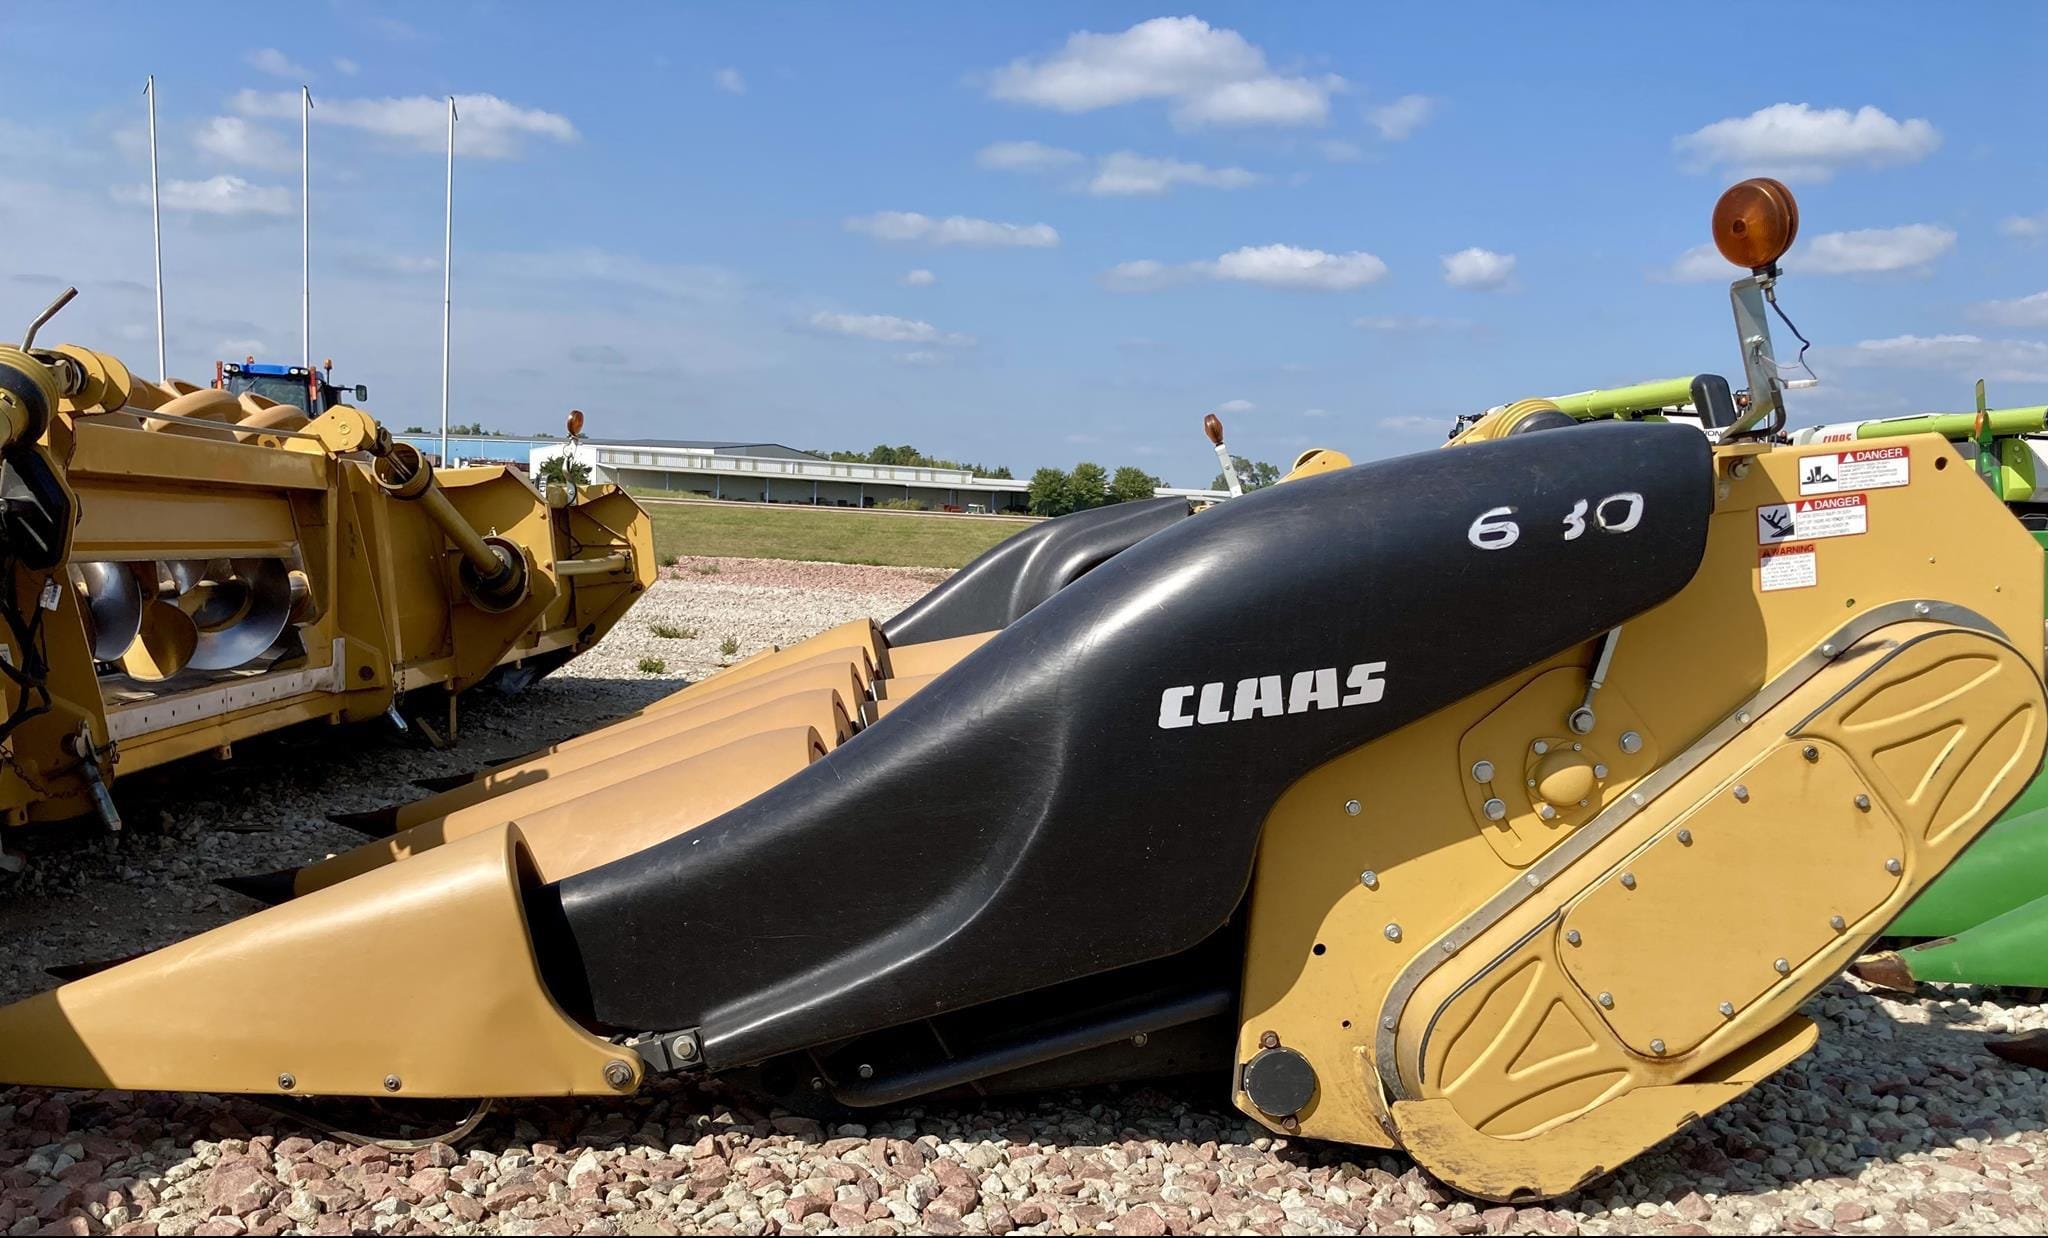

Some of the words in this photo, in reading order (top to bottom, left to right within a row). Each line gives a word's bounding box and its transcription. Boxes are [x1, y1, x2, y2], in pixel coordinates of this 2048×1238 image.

[1856, 448, 1903, 461] DANGER
[1814, 496, 1860, 510] DANGER
[1772, 544, 1814, 557] WARNING
[1158, 661, 1387, 729] CLAAS
